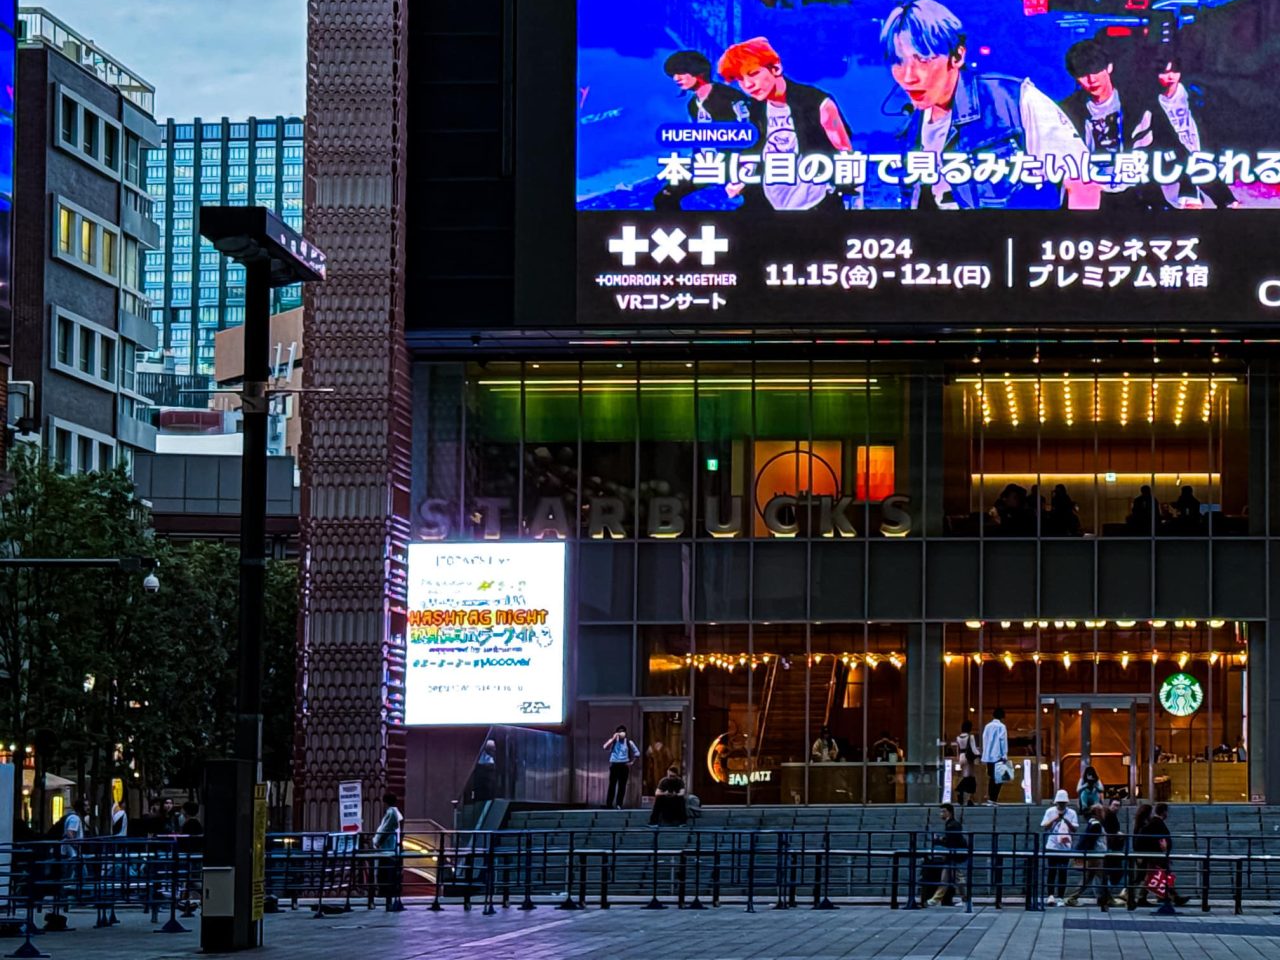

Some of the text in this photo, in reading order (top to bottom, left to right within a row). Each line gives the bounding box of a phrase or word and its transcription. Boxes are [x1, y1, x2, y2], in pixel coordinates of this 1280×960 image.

[662, 129, 752, 143] HUENINGKAI
[845, 239, 913, 259] 2024
[1041, 238, 1200, 262] 109シネマズ
[1028, 264, 1210, 289] プレミアム新宿
[616, 292, 727, 311] VRコンサート
[418, 496, 914, 539] STARBUCKS
[409, 609, 492, 627] HASHTAG
